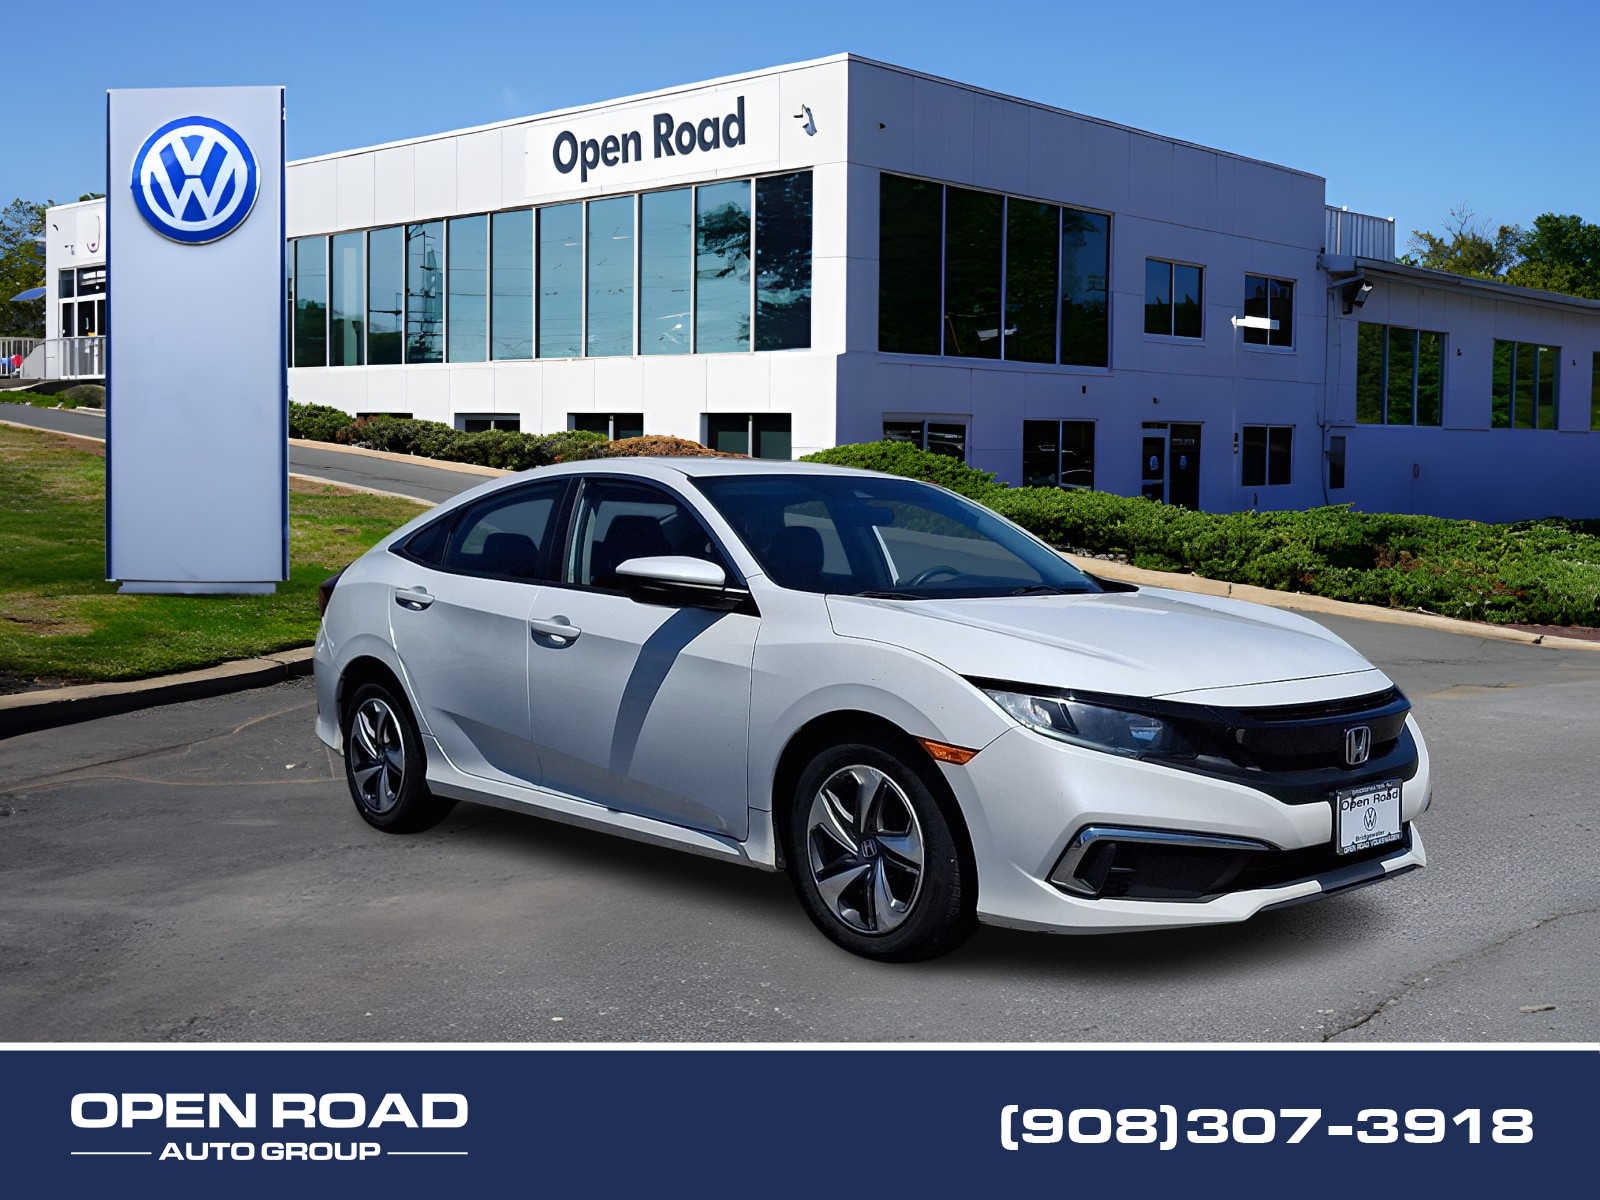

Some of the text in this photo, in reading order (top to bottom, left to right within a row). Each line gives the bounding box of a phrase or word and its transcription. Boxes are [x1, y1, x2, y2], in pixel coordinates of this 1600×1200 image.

[553, 95, 746, 183] Open Road
[1341, 790, 1398, 811] Open Road
